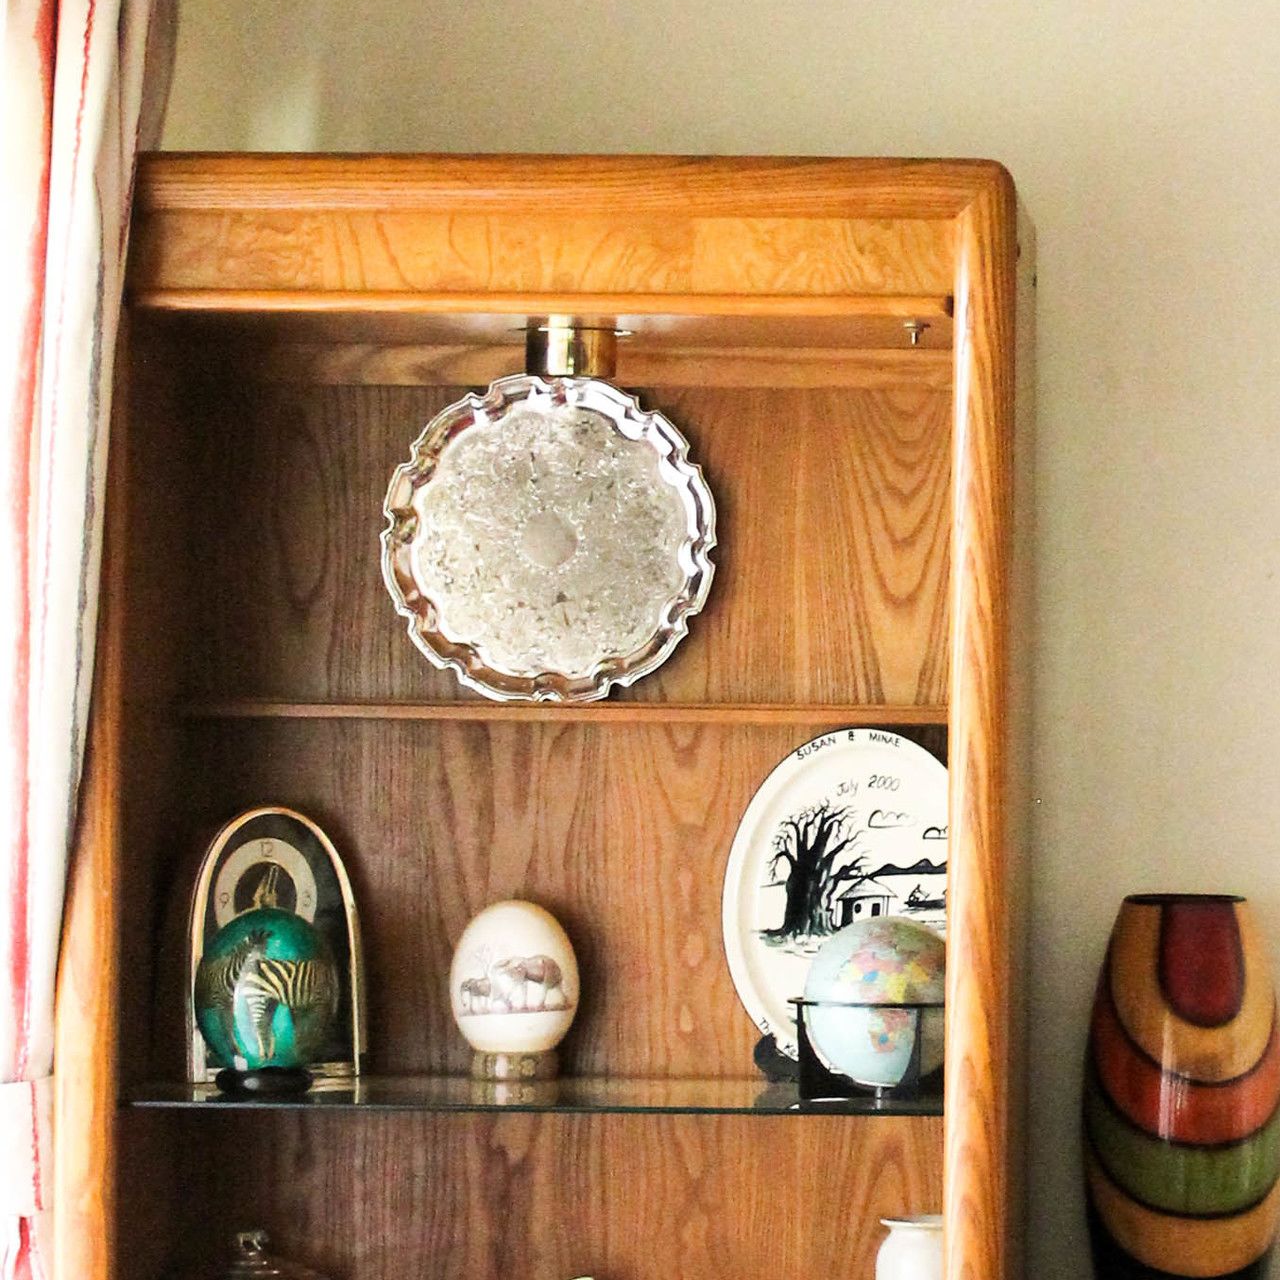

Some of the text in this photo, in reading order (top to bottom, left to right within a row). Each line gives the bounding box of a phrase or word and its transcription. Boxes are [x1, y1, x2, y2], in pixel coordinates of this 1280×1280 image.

[796, 736, 836, 760] SUSAN
[836, 774, 900, 796] July 2000
[261, 841, 274, 857] 12
[220, 892, 230, 909] 9
